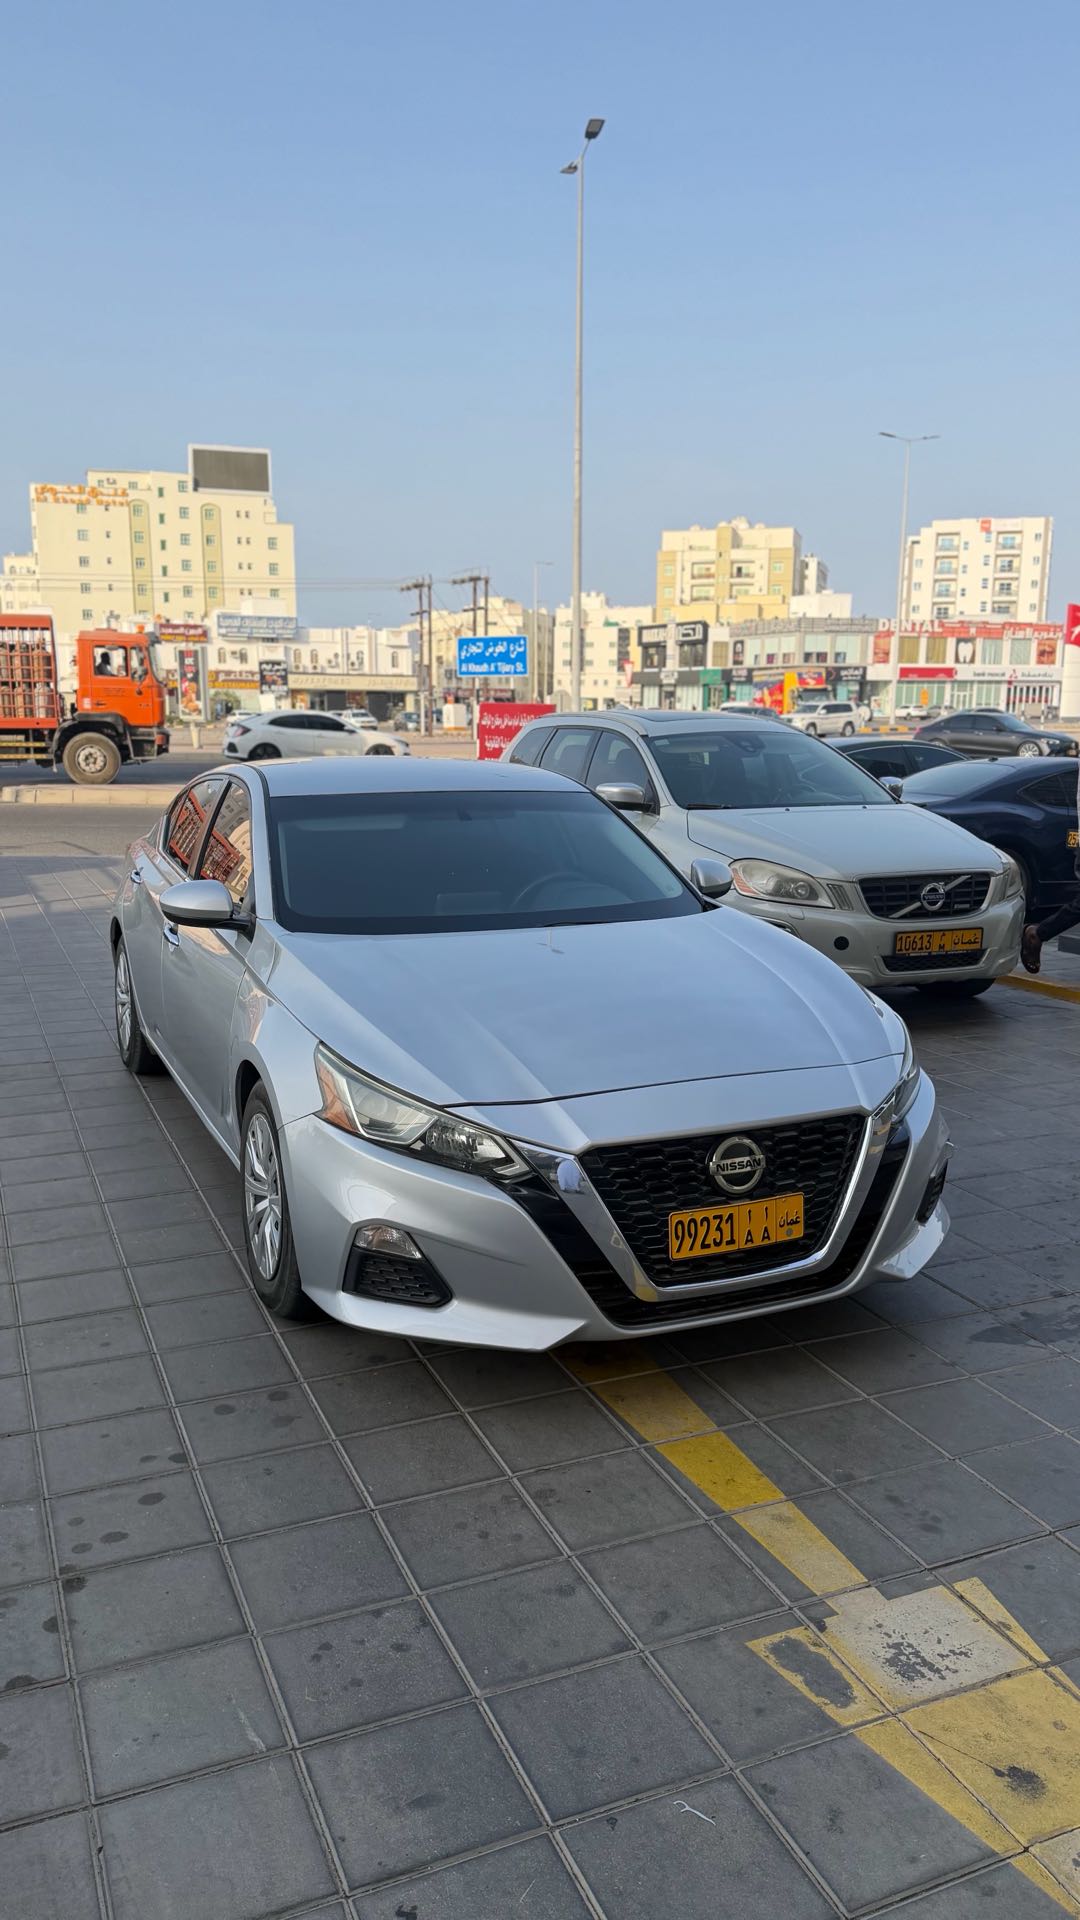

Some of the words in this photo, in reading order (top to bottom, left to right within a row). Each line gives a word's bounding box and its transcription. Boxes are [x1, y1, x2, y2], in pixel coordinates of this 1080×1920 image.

[878, 619, 943, 632] DENTAL
[461, 642, 483, 659] التجاري
[485, 641, 507, 657] الخوض
[510, 638, 525, 658] شارع
[897, 934, 932, 952] 10613
[938, 943, 945, 951] M
[716, 1157, 761, 1173] NISSAN
[674, 1212, 736, 1254] 99231
[744, 1229, 754, 1245] A
[761, 1226, 771, 1242] A
